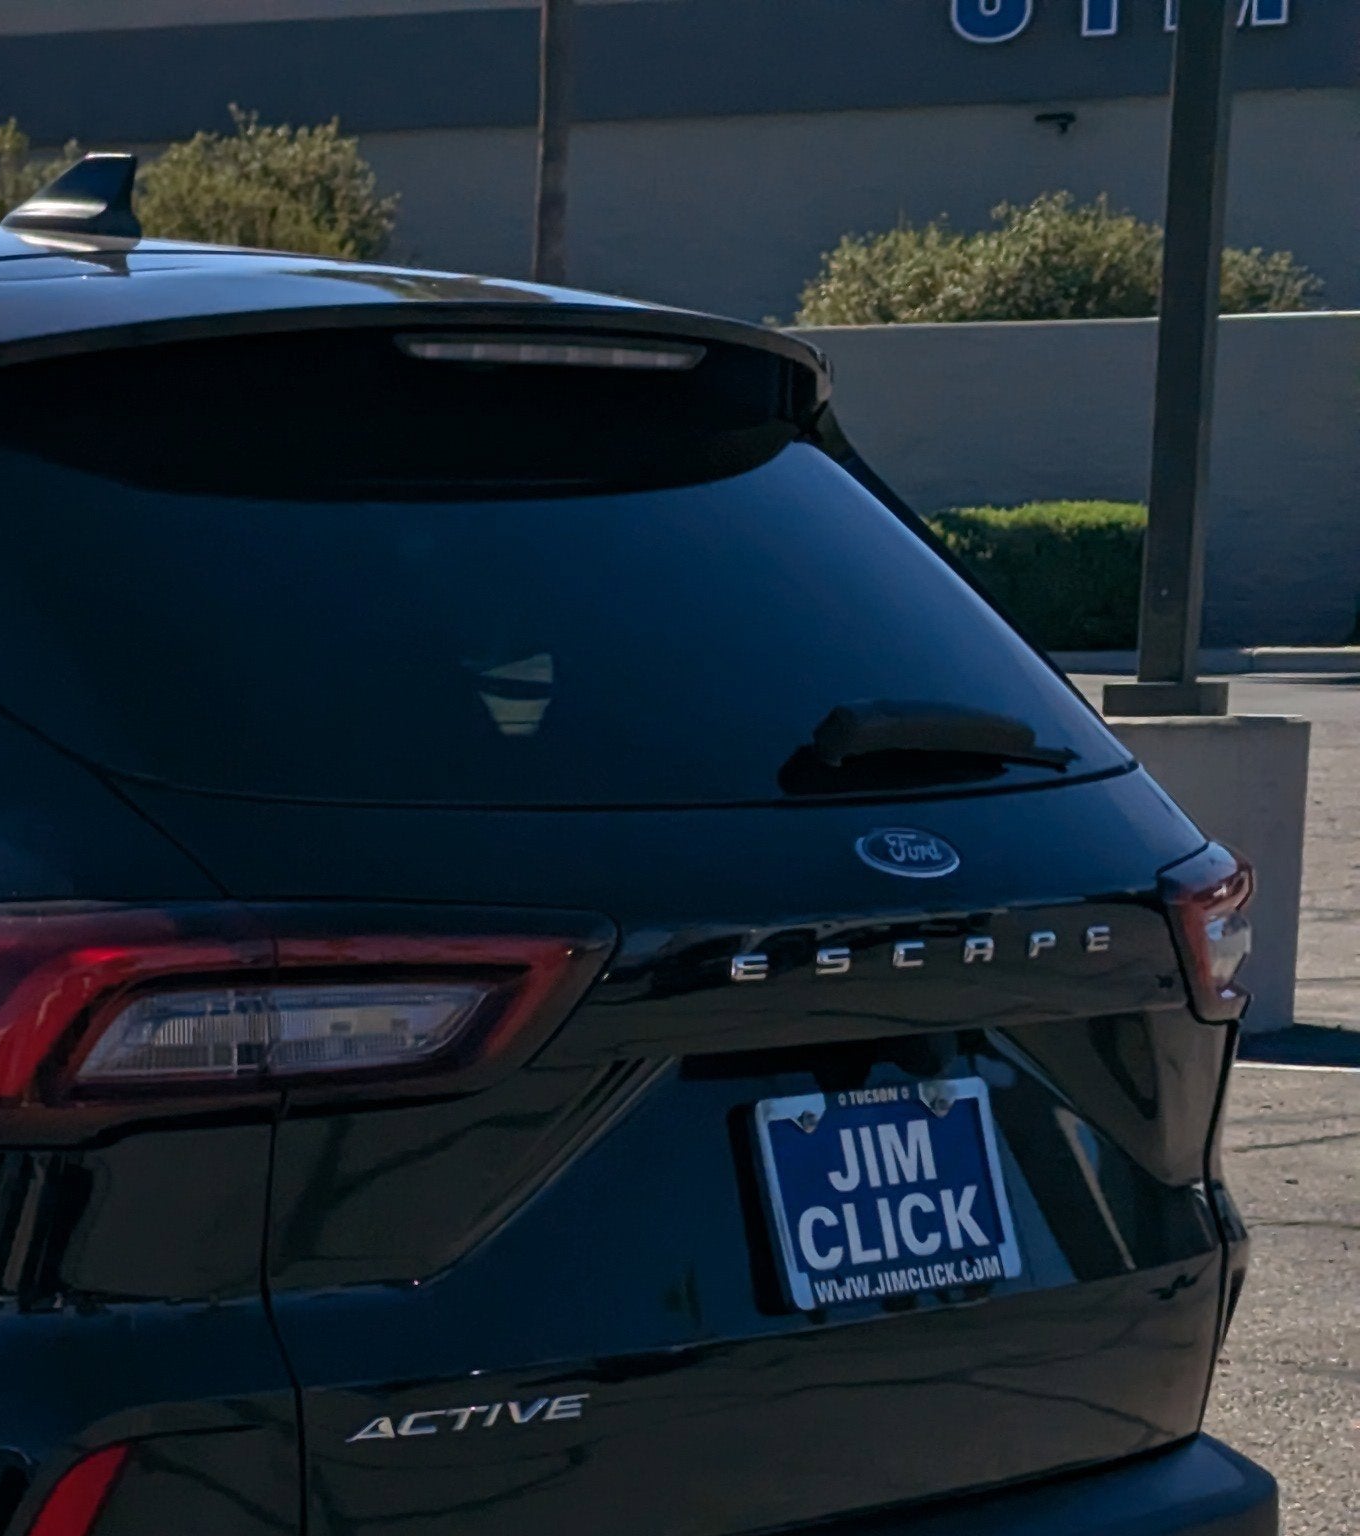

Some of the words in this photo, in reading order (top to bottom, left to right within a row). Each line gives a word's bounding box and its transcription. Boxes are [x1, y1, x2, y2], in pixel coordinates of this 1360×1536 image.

[884, 832, 943, 863] Ford
[731, 925, 1111, 982] ESCAPE
[849, 1086, 899, 1106] TUCSON
[828, 1119, 937, 1193] JIM
[798, 1185, 990, 1272] CLICK
[814, 1254, 1002, 1304] WWW.JIMCLICK.COM
[345, 1393, 590, 1443] ACTIVE
